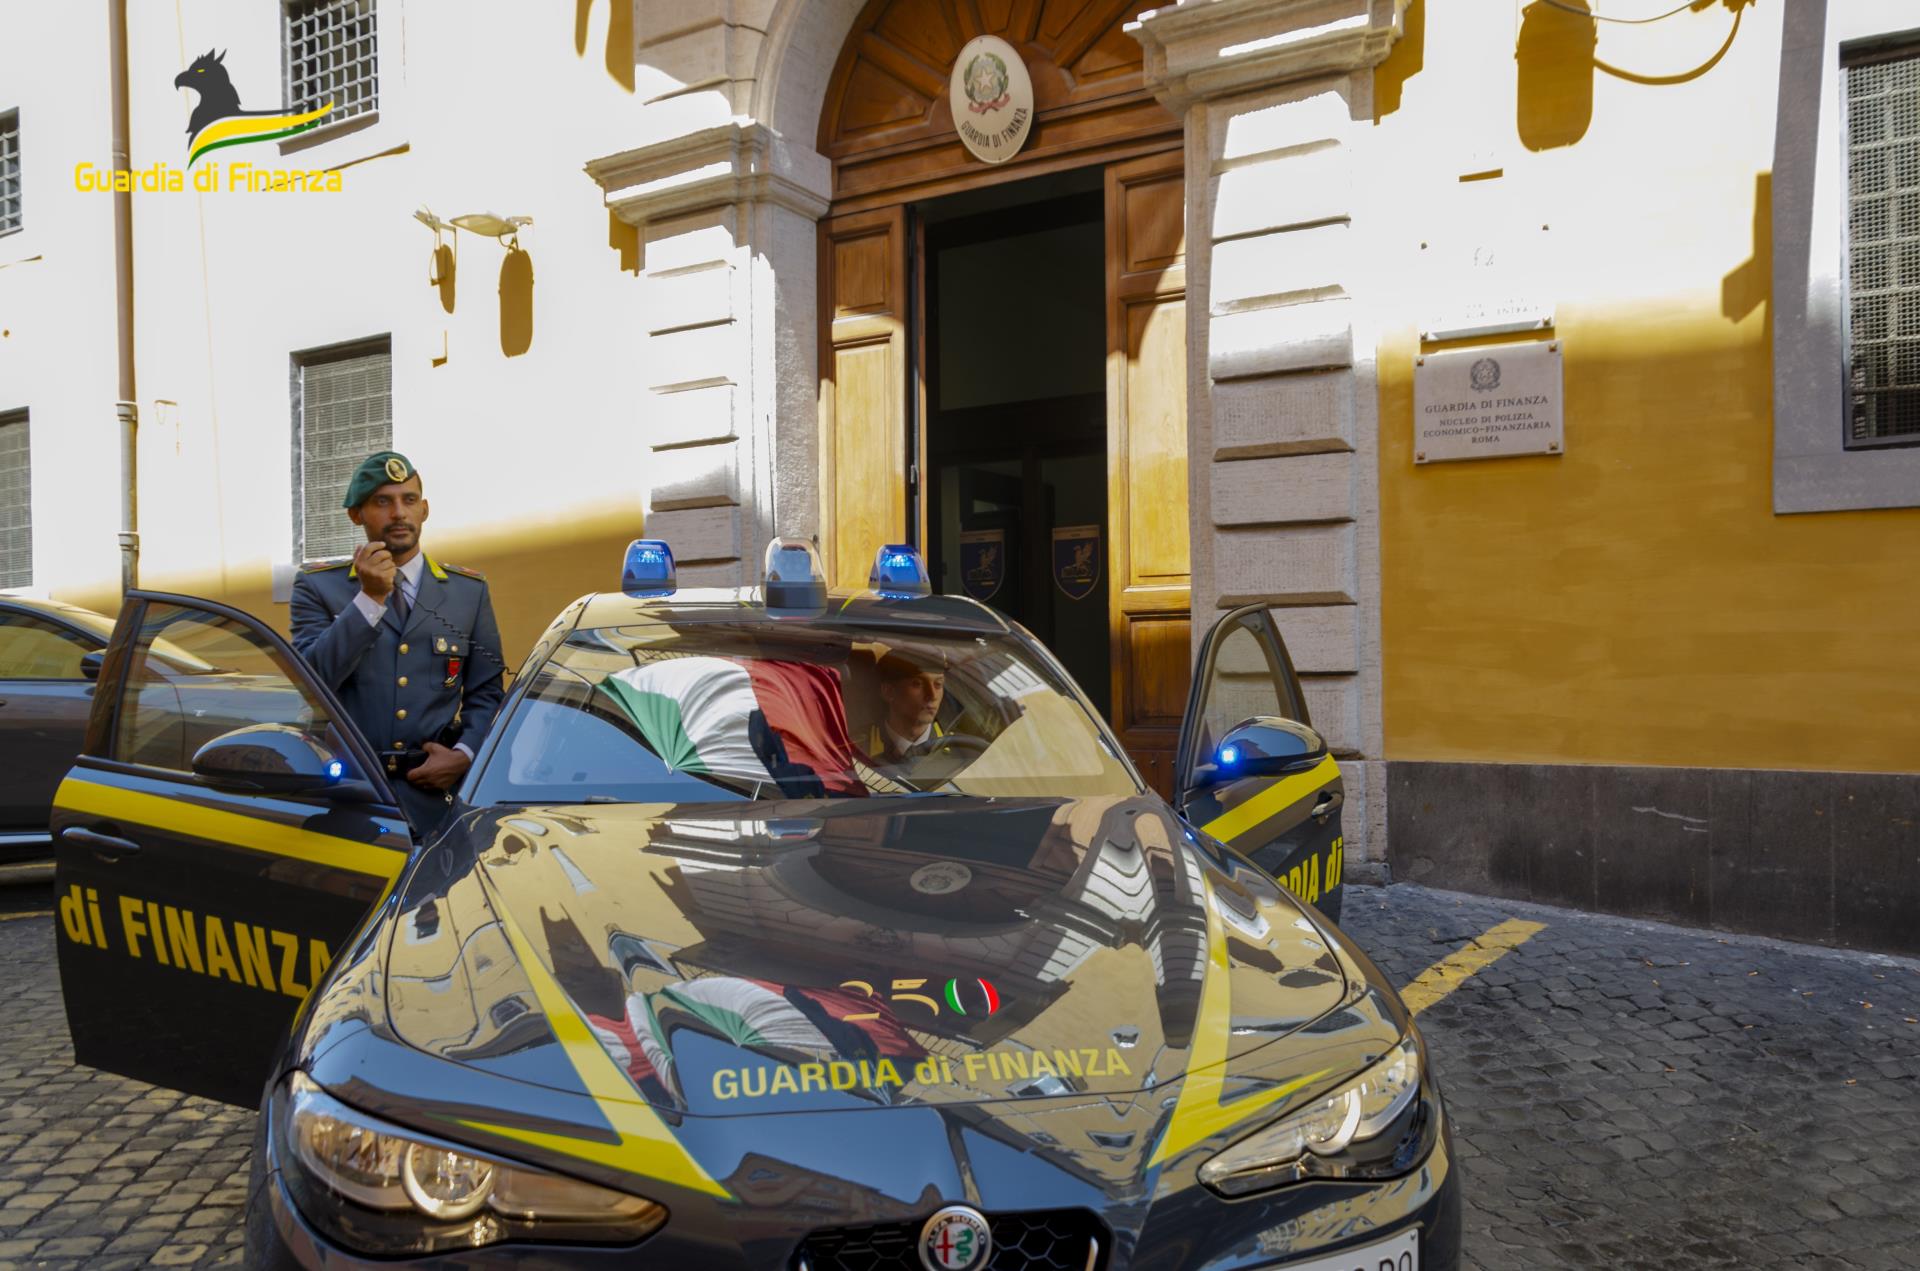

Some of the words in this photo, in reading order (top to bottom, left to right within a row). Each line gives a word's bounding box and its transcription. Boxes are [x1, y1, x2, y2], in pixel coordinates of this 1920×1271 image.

[960, 120, 990, 148] GUARDIA
[992, 135, 1002, 148] DI
[1001, 107, 1028, 142] FINANZA
[1424, 402, 1477, 414] GUARDIA
[1481, 400, 1493, 409] DI
[1496, 395, 1549, 408] FINANZA
[1439, 416, 1478, 426] NUCLEO
[1481, 416, 1492, 424] DI
[1495, 412, 1534, 422] POLIZIA
[1423, 421, 1552, 438] ECONOMICO-FINANZIARIA
[1471, 435, 1500, 444] ROMA
[1325, 836, 1342, 894] di
[60, 884, 108, 950] di
[119, 895, 334, 1000] FINANZA
[712, 1058, 904, 1100] GUARDIA
[914, 1055, 953, 1086] di
[963, 1048, 1132, 1082] FINANZA
